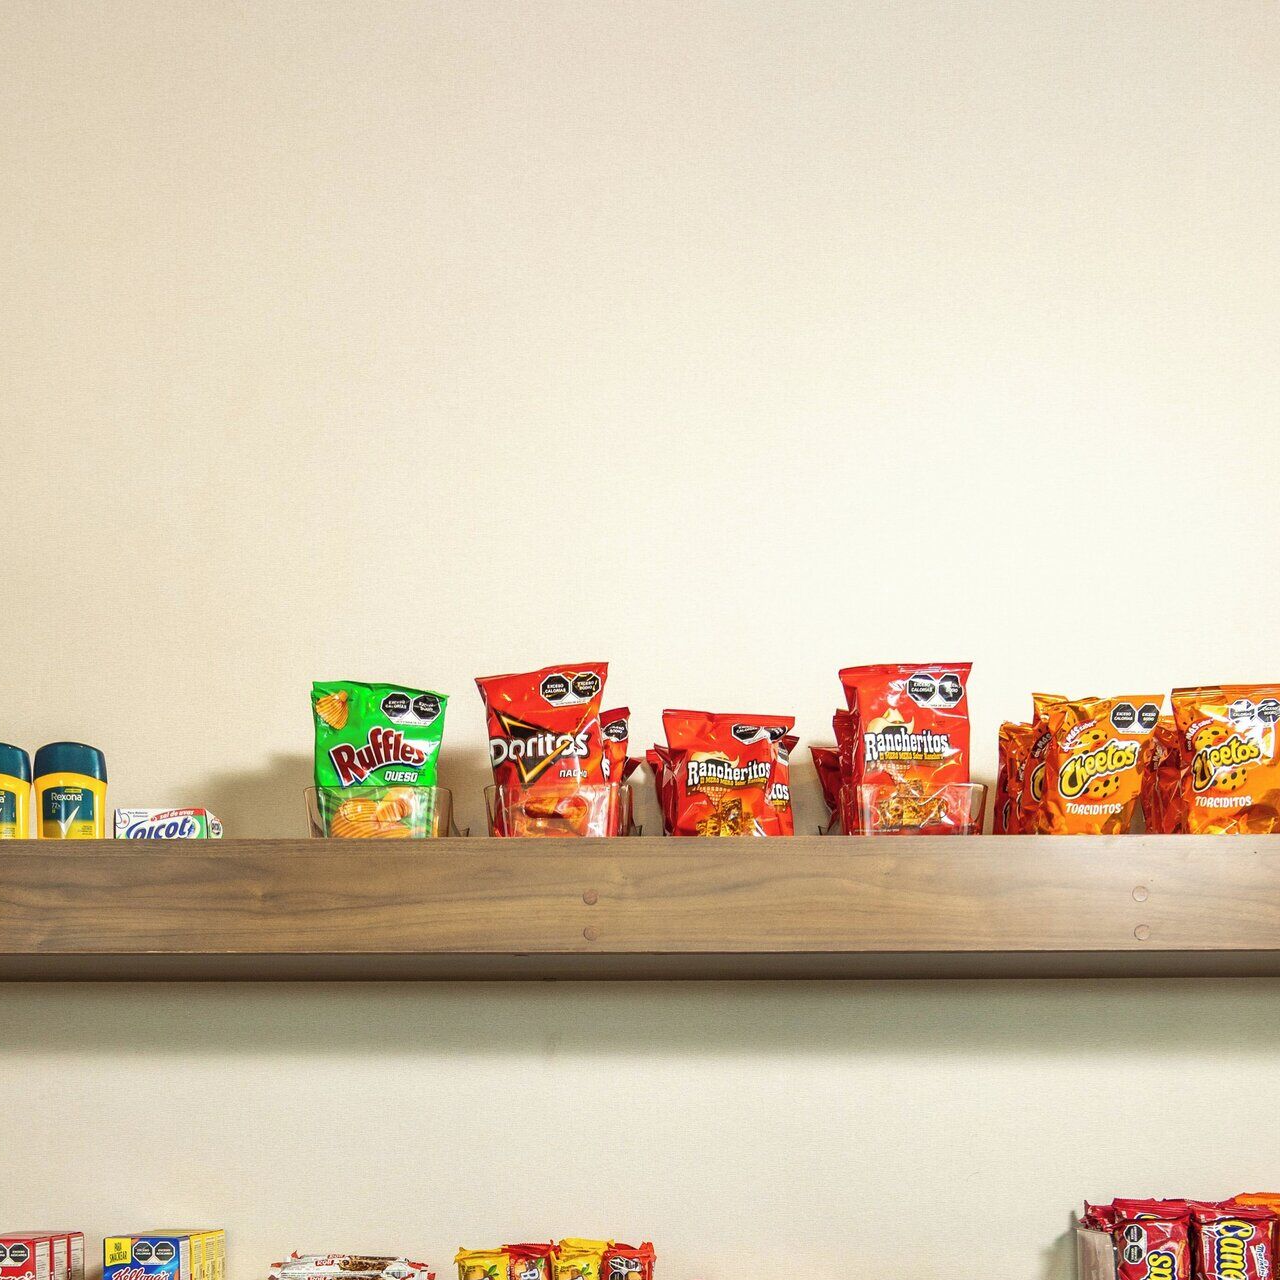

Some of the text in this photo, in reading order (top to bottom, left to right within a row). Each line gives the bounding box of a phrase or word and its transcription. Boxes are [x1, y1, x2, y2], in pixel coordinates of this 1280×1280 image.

[489, 734, 590, 768] Doritos
[864, 729, 948, 761] Rancheritos
[330, 727, 426, 787] Ruffles
[385, 771, 418, 782] QUESO
[688, 760, 771, 786] Rancheritos
[1059, 740, 1140, 799] Cheetos
[51, 793, 82, 801] Rexona
[1195, 796, 1252, 807] TORCIDITOS
[160, 811, 169, 819] sal
[1066, 803, 1121, 815] TORCIDITOS
